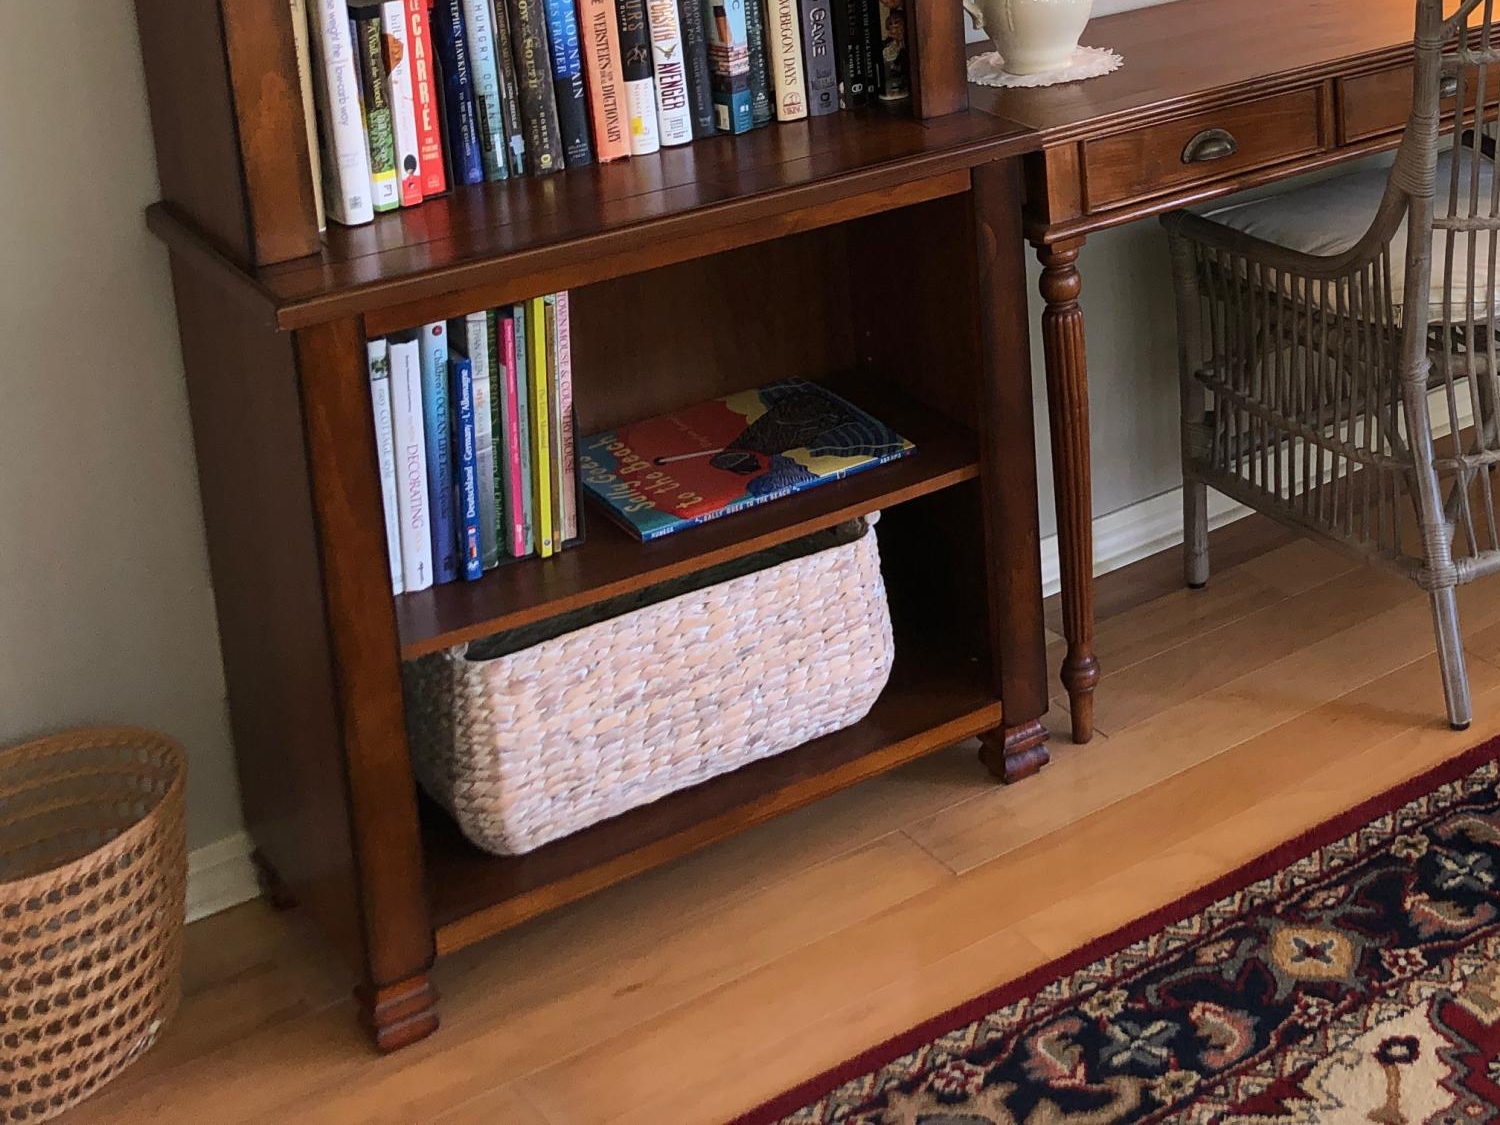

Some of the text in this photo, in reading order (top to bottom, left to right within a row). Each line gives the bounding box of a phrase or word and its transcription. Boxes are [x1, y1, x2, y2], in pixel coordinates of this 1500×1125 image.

[325, 11, 341, 42] weight
[390, 13, 402, 34] bill
[593, 12, 613, 70] WEBSTER'S
[809, 7, 828, 58] GAME
[332, 43, 343, 58] the
[454, 39, 467, 85] HAWKING
[474, 4, 489, 62] HUNGRY
[483, 74, 496, 120] OCEAN
[551, 21, 567, 73] FRAZIER
[564, 10, 584, 100] MOUNTAIN
[372, 79, 385, 107] Woods
[656, 62, 686, 111] AVENGER
[783, 57, 797, 86] DAYS
[337, 106, 351, 126] way
[531, 118, 540, 146] HICKS
[539, 111, 549, 149] ROBERT
[601, 84, 621, 144] DICTIONARY
[471, 323, 482, 353] ETHAN
[433, 348, 447, 461] Children's OCEAN LIFE
[557, 290, 574, 475] TOWN MOUSE & COUNTRY MOUSE
[378, 409, 390, 455] COTTAGE
[463, 424, 473, 461] Germany
[406, 443, 423, 529] DECORATING
[462, 466, 476, 518] Deutschland
[588, 435, 704, 510] to the Beach
[493, 492, 502, 530] Children
[604, 480, 656, 513] Sally
[703, 511, 724, 523] SALLY
[756, 494, 768, 504] THE
[770, 487, 791, 501] BEACH
